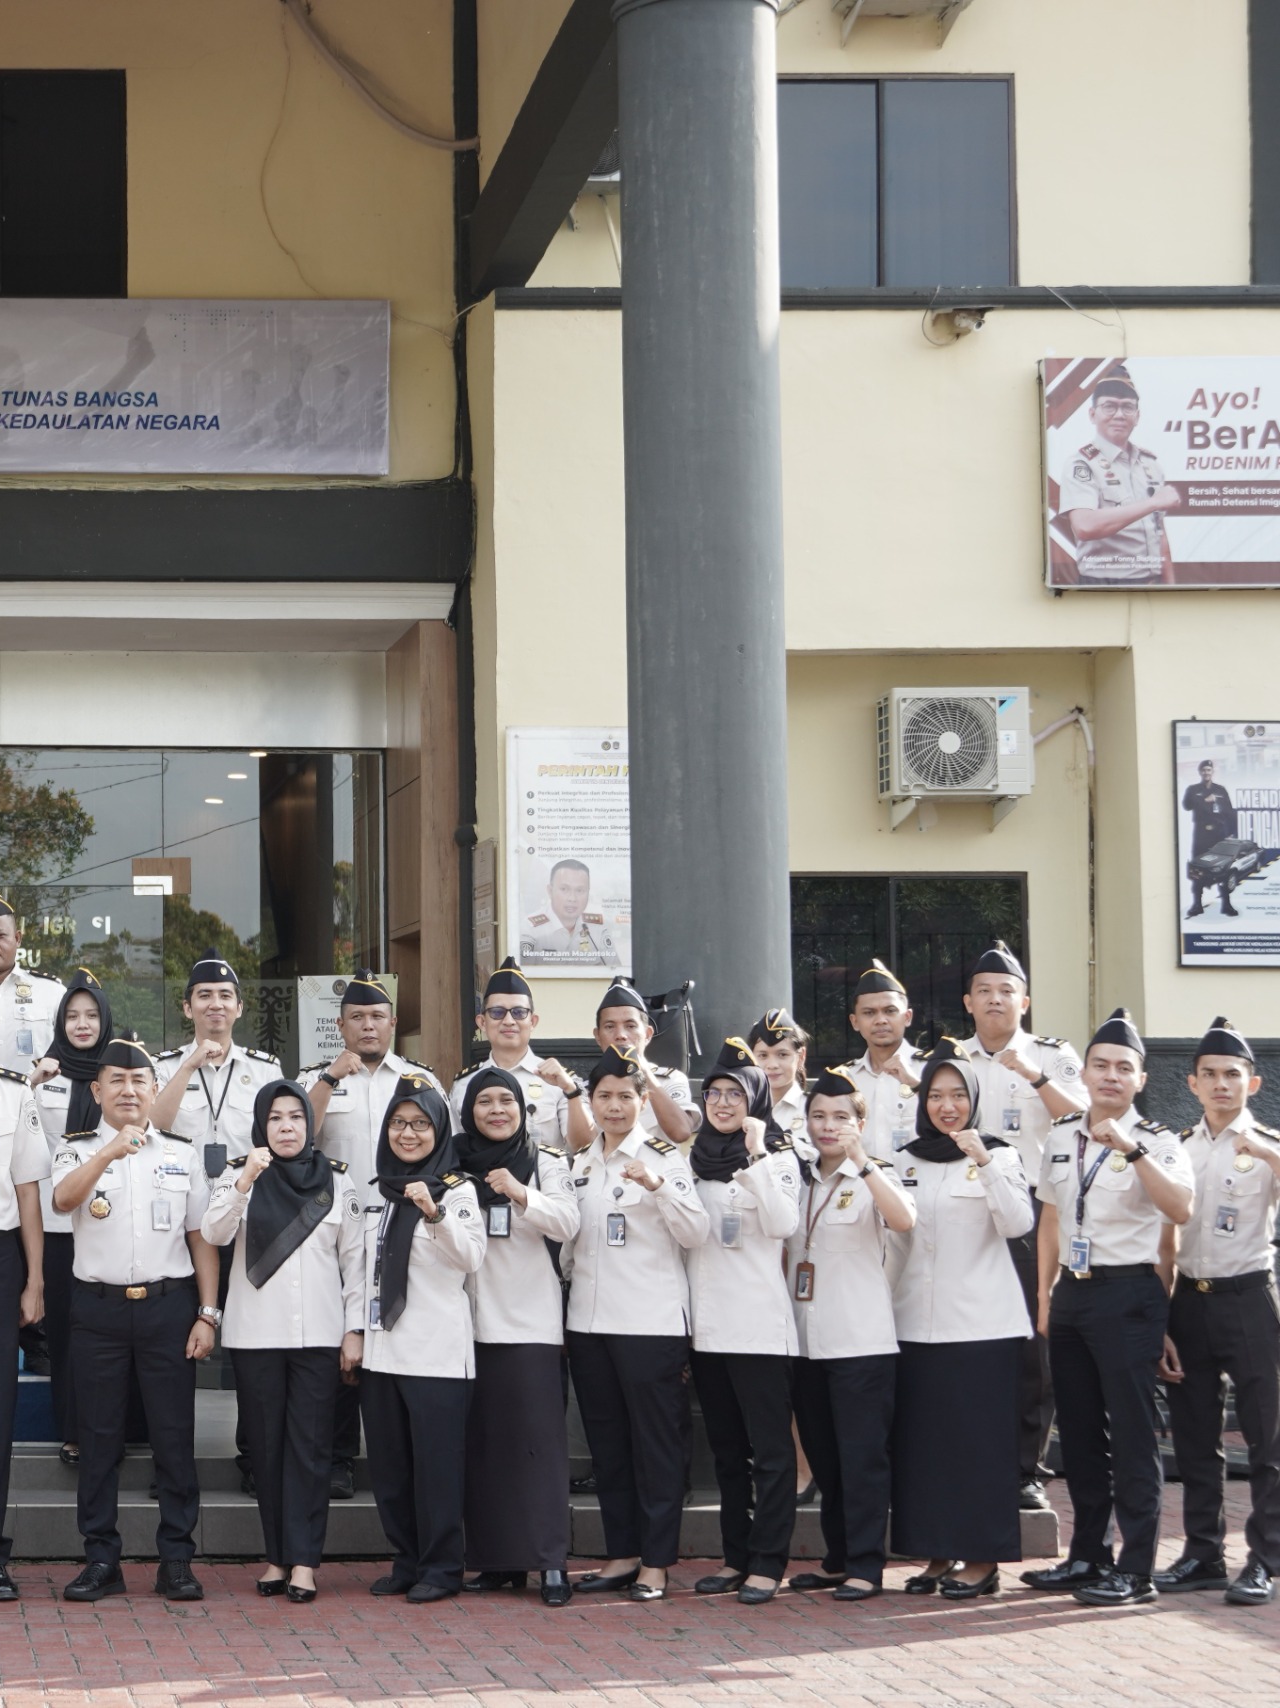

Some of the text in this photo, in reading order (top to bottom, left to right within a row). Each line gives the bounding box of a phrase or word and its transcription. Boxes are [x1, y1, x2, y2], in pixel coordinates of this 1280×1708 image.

[1, 391, 68, 407] TUNAS
[74, 391, 159, 408] BANGSA
[1186, 387, 1261, 418] Ayo!
[136, 414, 221, 431] NEGARA
[1185, 456, 1271, 470] RUDENIM
[1188, 487, 1221, 497] Bersih,
[1222, 487, 1249, 495] Sehat
[1188, 498, 1280, 507] Rumah Detensi Imig
[537, 764, 620, 777] PERINTAH
[1236, 788, 1280, 809] MEND
